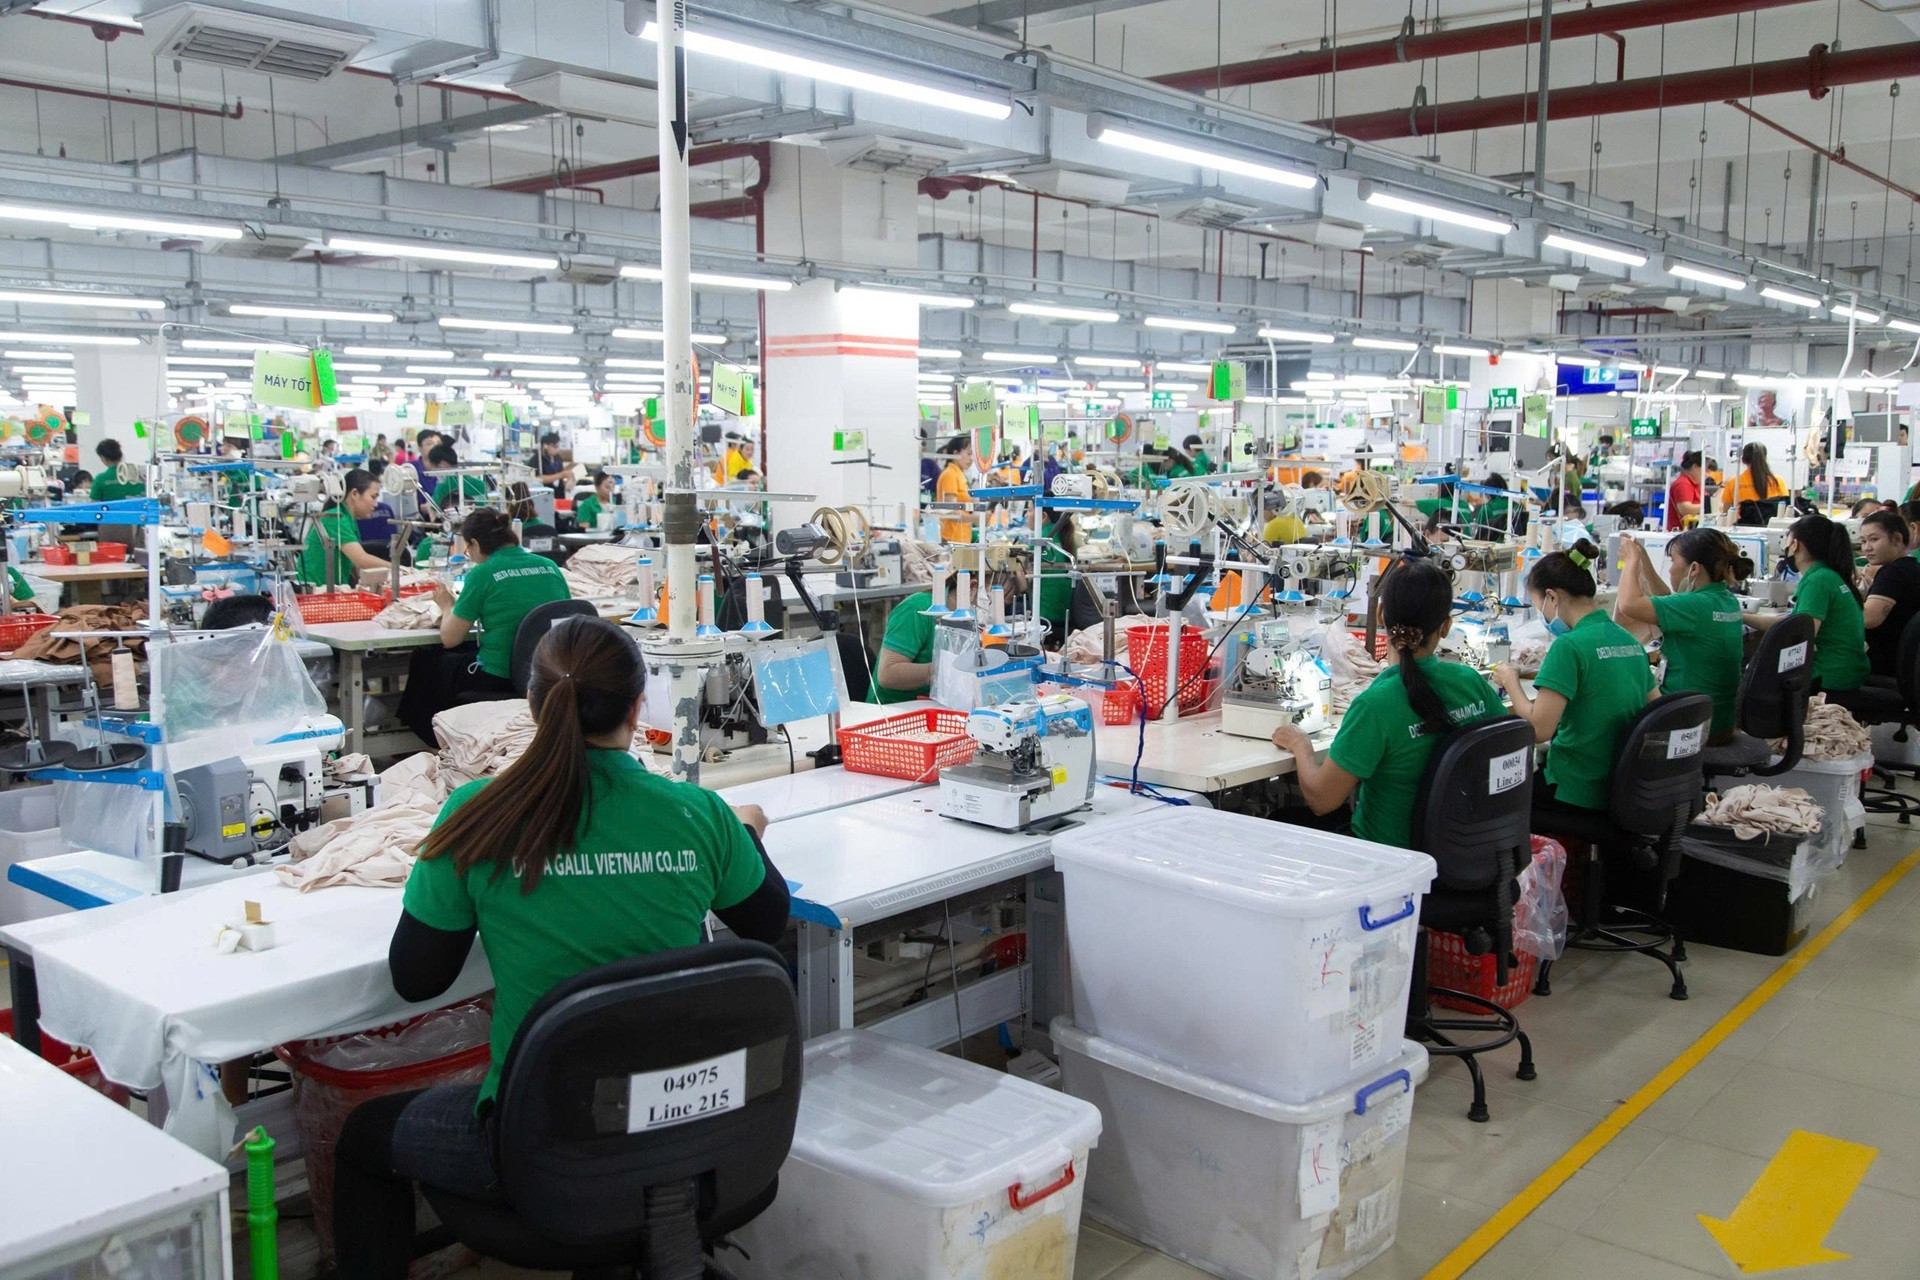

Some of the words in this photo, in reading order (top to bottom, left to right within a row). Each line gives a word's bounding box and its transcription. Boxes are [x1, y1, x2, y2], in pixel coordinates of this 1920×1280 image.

[674, 0, 684, 31] OMP.
[264, 374, 288, 388] MÁY
[291, 377, 312, 392] TỐT
[1496, 776, 1512, 788] Line
[554, 853, 594, 876] GALIL
[595, 851, 653, 875] VIETNAM
[663, 1065, 718, 1093] 04975
[648, 1103, 692, 1123] Line
[699, 1088, 730, 1112] 215
